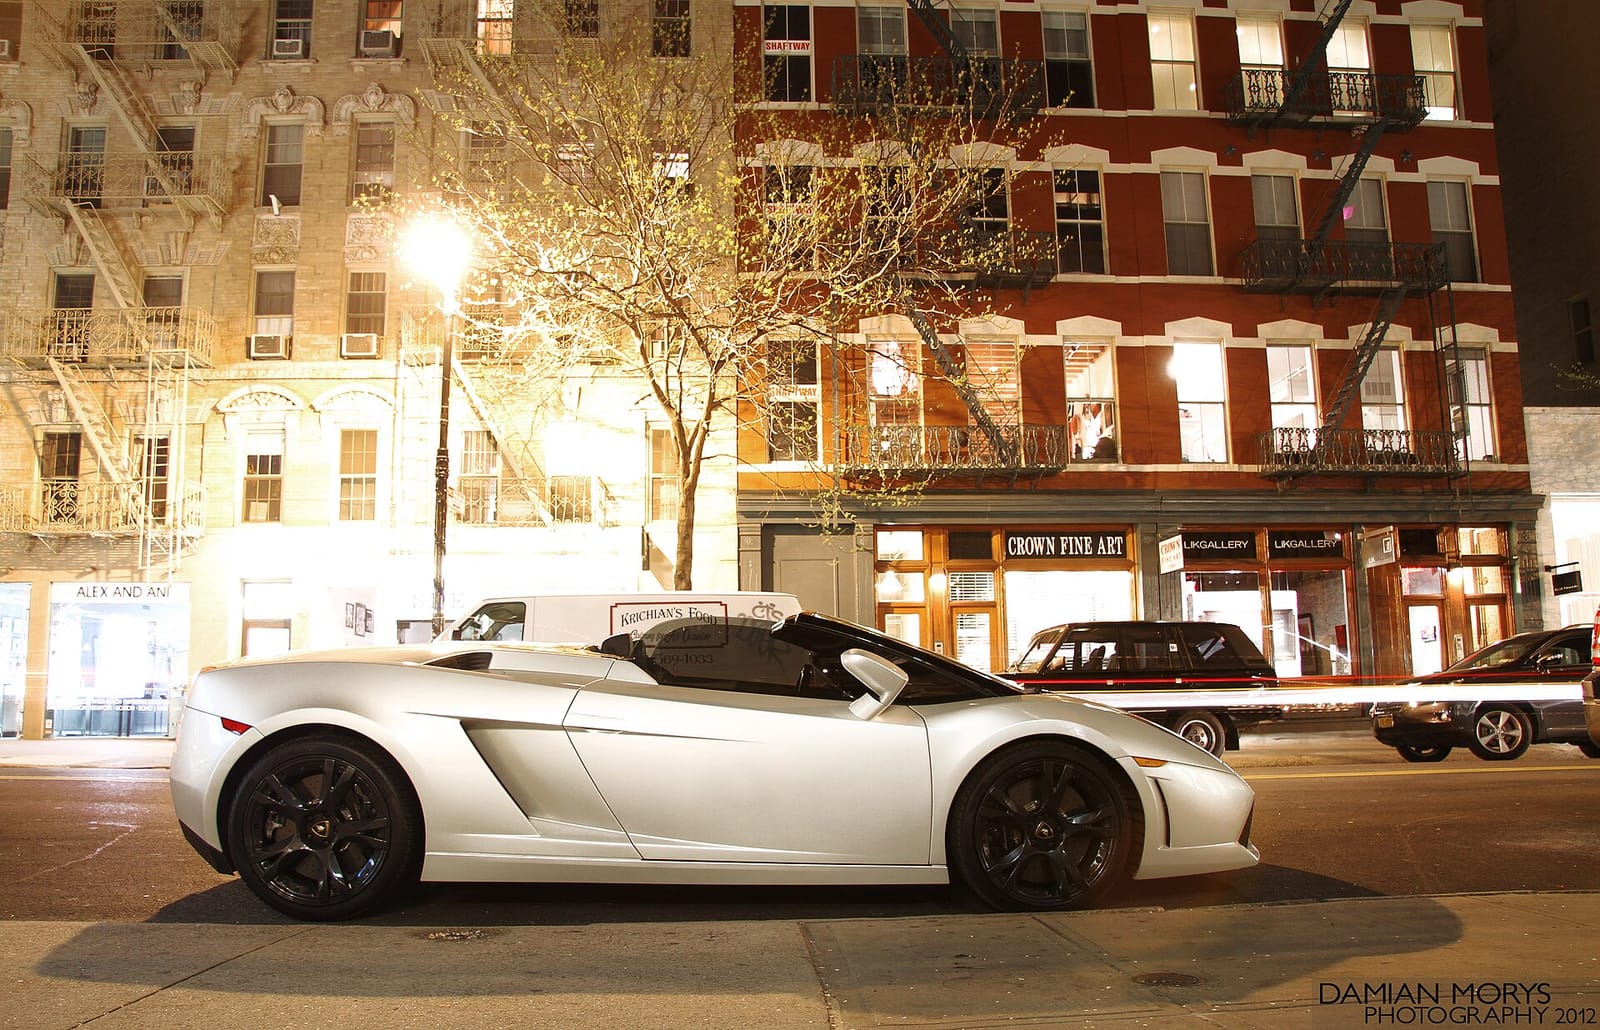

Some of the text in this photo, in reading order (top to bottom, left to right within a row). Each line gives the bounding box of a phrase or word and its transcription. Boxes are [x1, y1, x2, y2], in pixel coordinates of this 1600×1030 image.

[766, 42, 810, 50] SHAFTWAY
[1008, 535, 1124, 556] CROWN FINE ART
[1183, 540, 1249, 550] LIKGALLERY
[1274, 539, 1338, 549] LIKGALLERY
[76, 586, 170, 598] ALEX AND ANI
[621, 607, 683, 627] KRICHIAN'S
[688, 607, 717, 626] FOOD
